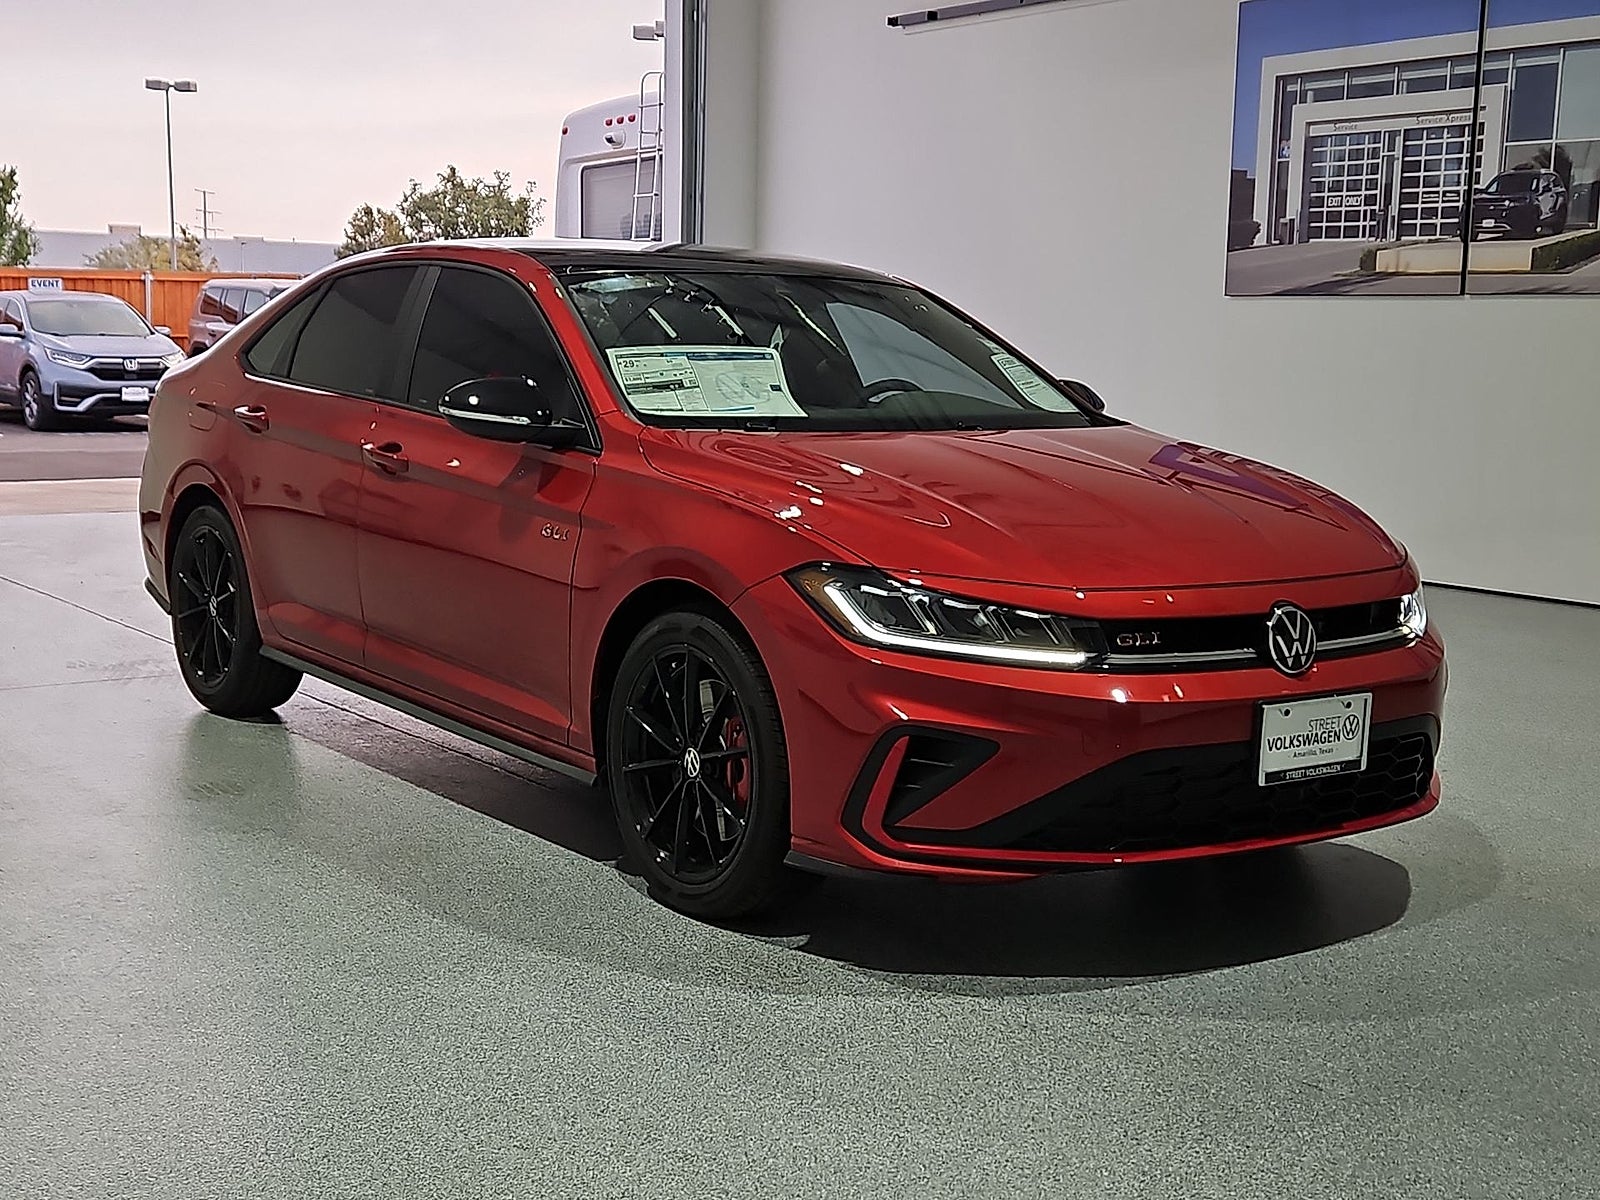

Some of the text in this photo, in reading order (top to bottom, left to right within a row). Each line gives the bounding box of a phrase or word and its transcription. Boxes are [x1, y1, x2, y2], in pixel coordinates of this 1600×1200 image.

[31, 279, 60, 288] EVENT
[1116, 631, 1162, 646] GLI
[1308, 716, 1342, 732] STREET
[1267, 729, 1342, 752] VOLKSWAGEN
